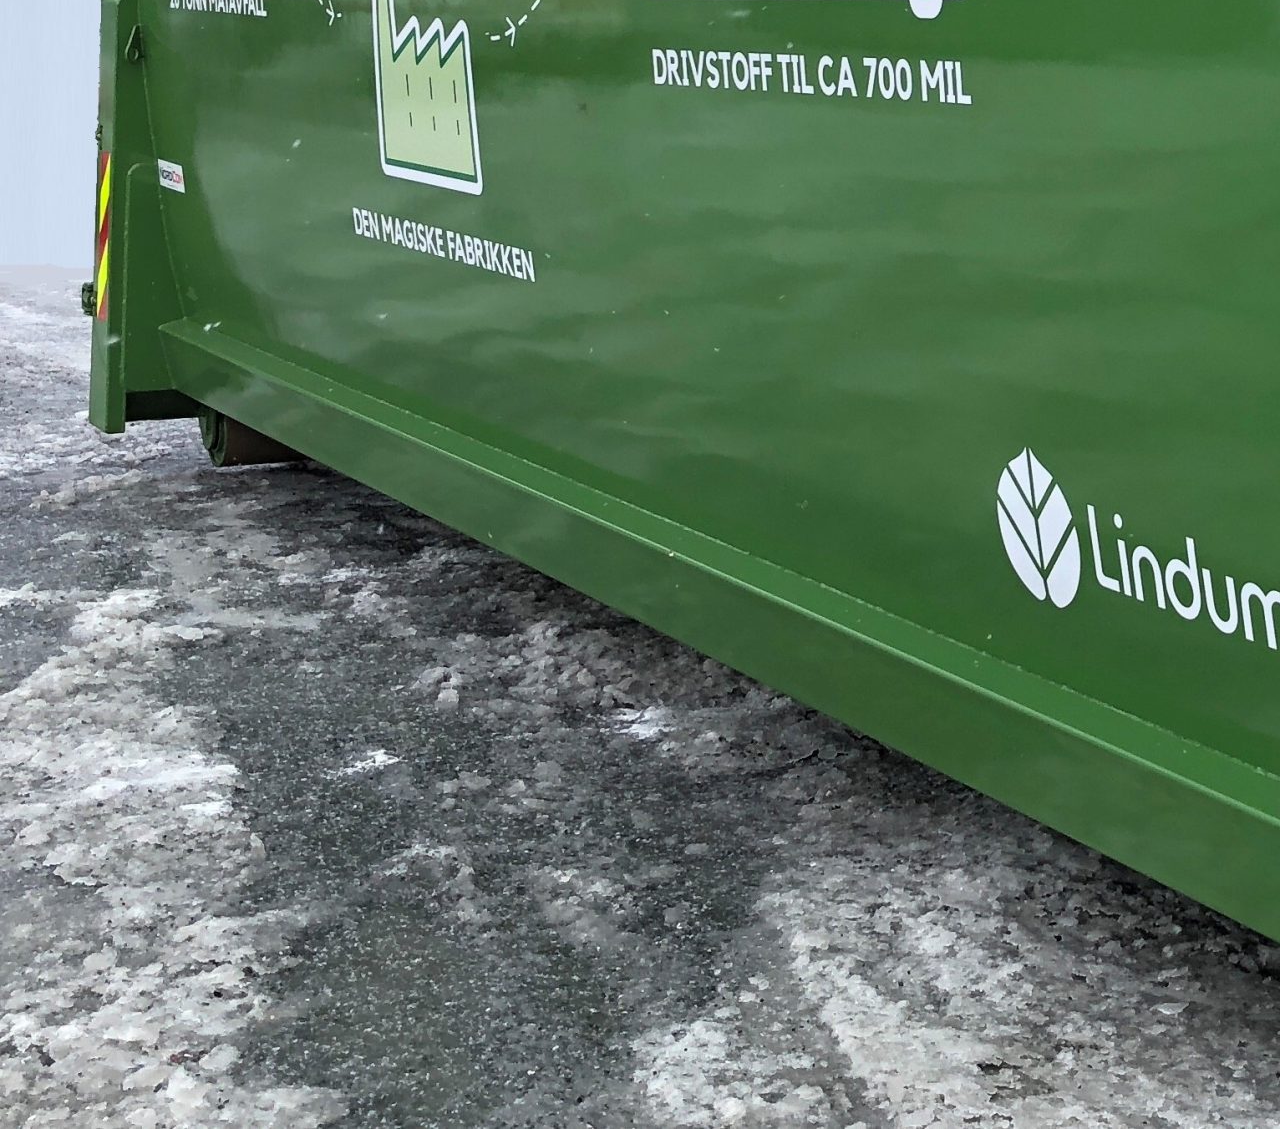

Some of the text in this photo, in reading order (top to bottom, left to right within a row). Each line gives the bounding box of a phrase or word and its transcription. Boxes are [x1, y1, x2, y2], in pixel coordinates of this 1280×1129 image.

[652, 48, 972, 105] DRIVSTOFF TIL CA 700 MIL
[352, 207, 536, 283] DEN MAGISKE FABRIKKEN
